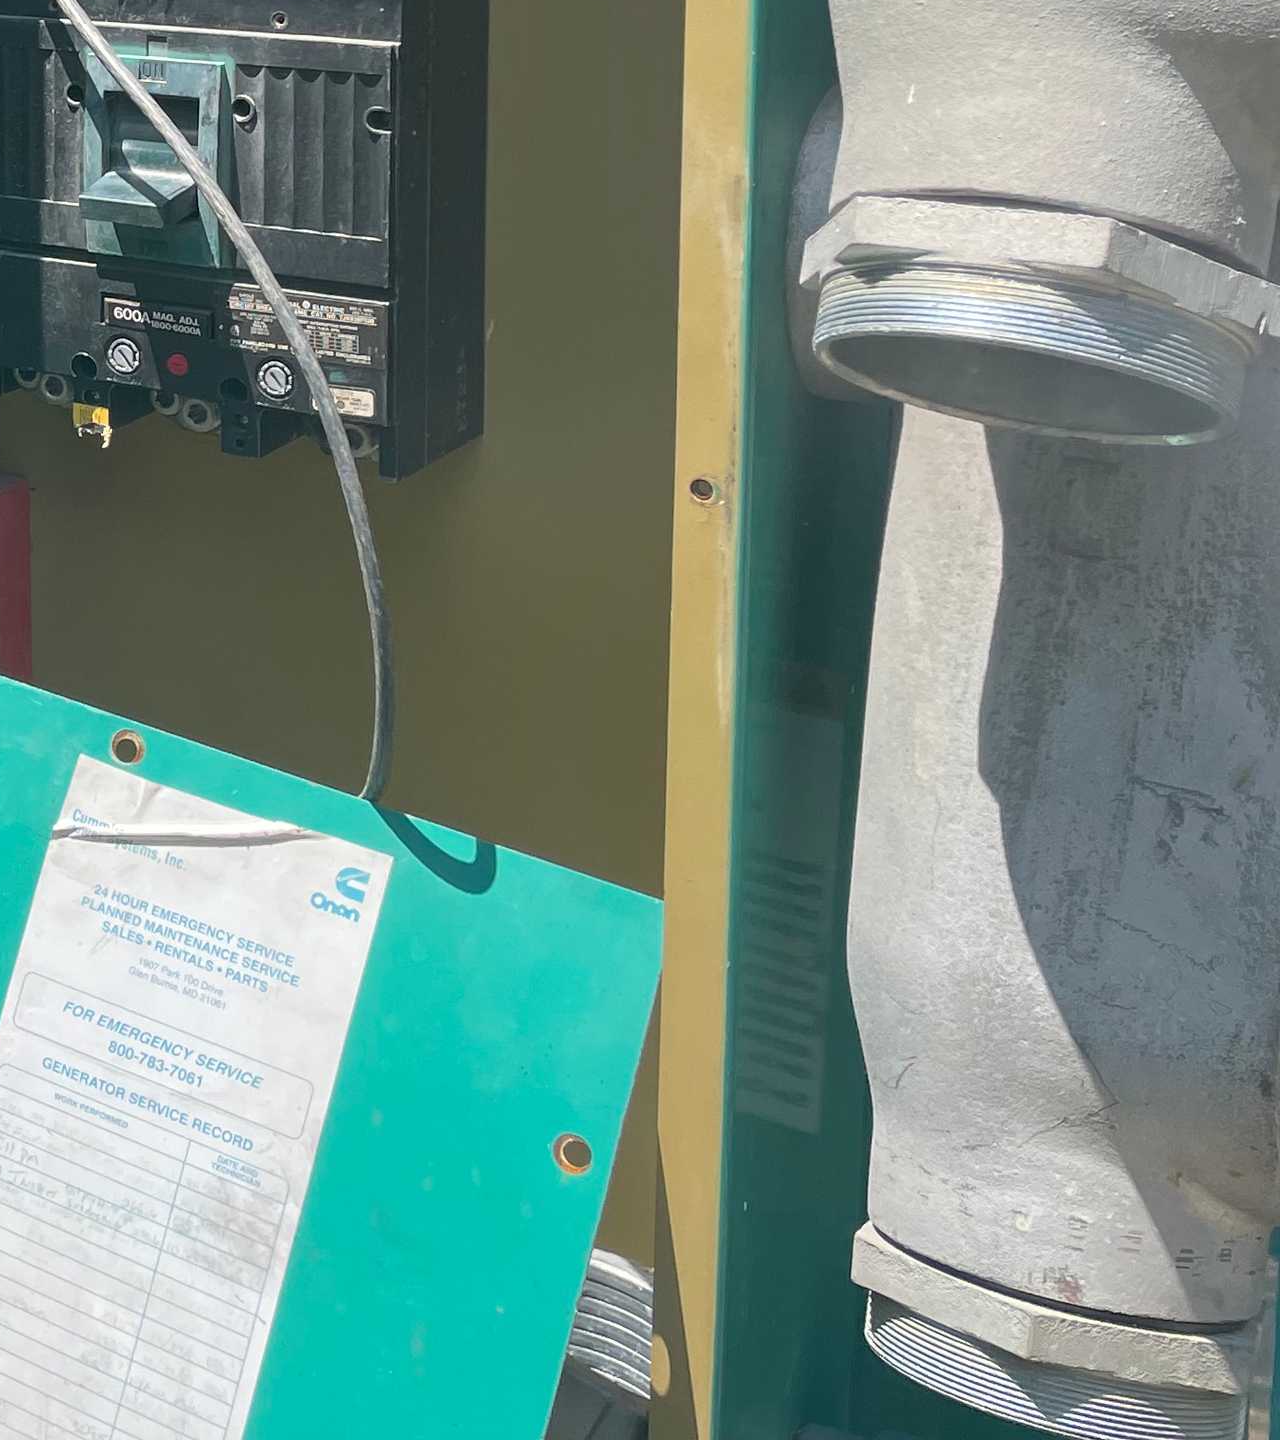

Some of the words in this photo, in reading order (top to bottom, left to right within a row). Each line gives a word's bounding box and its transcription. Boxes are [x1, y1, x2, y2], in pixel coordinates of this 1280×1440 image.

[113, 306, 151, 324] 600A
[78, 895, 143, 928] PLANNED
[141, 919, 240, 965] MAINTENANCE
[240, 956, 301, 987] SERVICE
[92, 883, 110, 899] 24
[108, 890, 149, 914] HOUR
[148, 904, 235, 945] EMERGENCY
[234, 936, 296, 968] SERVICE
[308, 890, 363, 923] Onan
[99, 920, 146, 946] SALES
[152, 940, 216, 973] RENTALS
[223, 967, 270, 993] PARTS
[61, 999, 96, 1023] FOR
[94, 1013, 195, 1062] EMERGENCY
[193, 1052, 264, 1090] SERVICE
[105, 1040, 206, 1089] 800-783-7061
[38, 1056, 128, 1100] GENERATOR
[126, 1091, 191, 1126] SERVICE
[189, 1116, 255, 1153] RECORD
